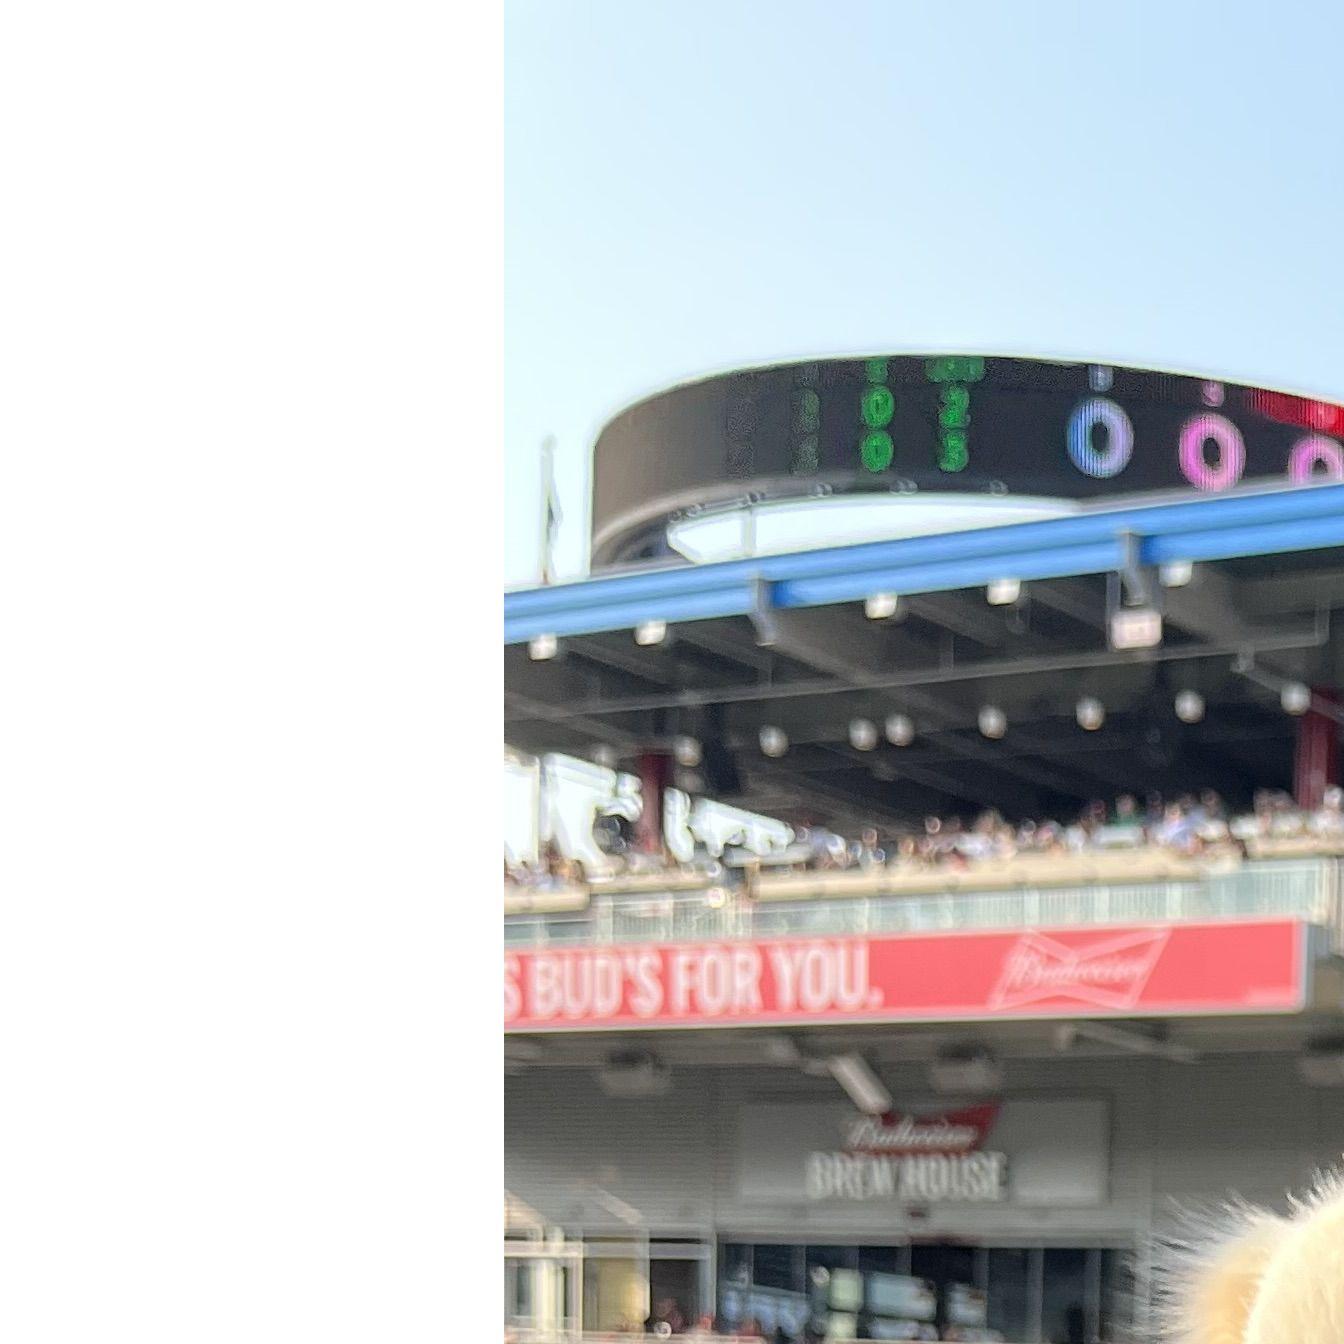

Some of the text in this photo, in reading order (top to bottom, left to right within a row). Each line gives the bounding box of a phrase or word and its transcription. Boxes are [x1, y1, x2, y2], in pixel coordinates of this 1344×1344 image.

[1067, 397, 1134, 478] 0
[528, 947, 663, 1020] BUD'S
[671, 943, 763, 1017] FOR
[768, 939, 884, 1013] YOU.
